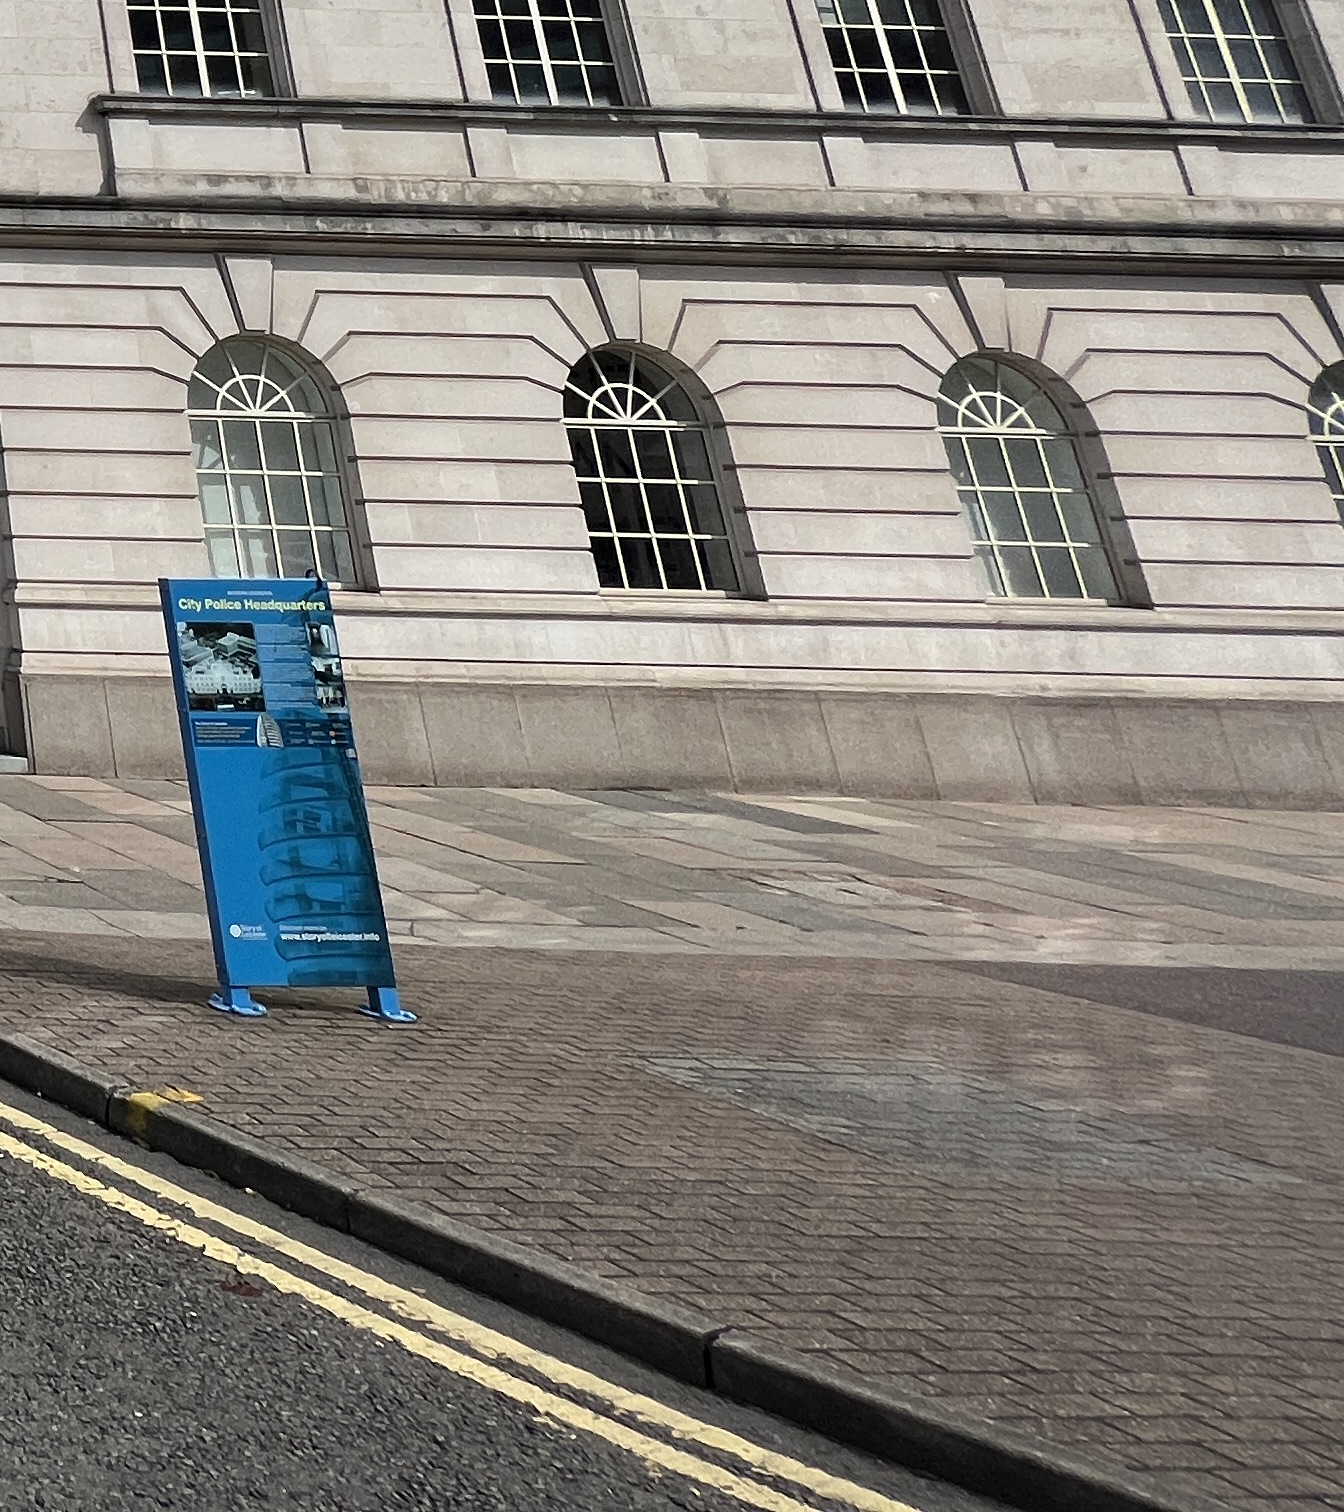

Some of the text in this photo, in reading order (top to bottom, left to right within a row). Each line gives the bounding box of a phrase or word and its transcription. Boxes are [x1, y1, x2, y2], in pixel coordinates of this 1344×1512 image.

[178, 598, 326, 613] City Police Headquarters
